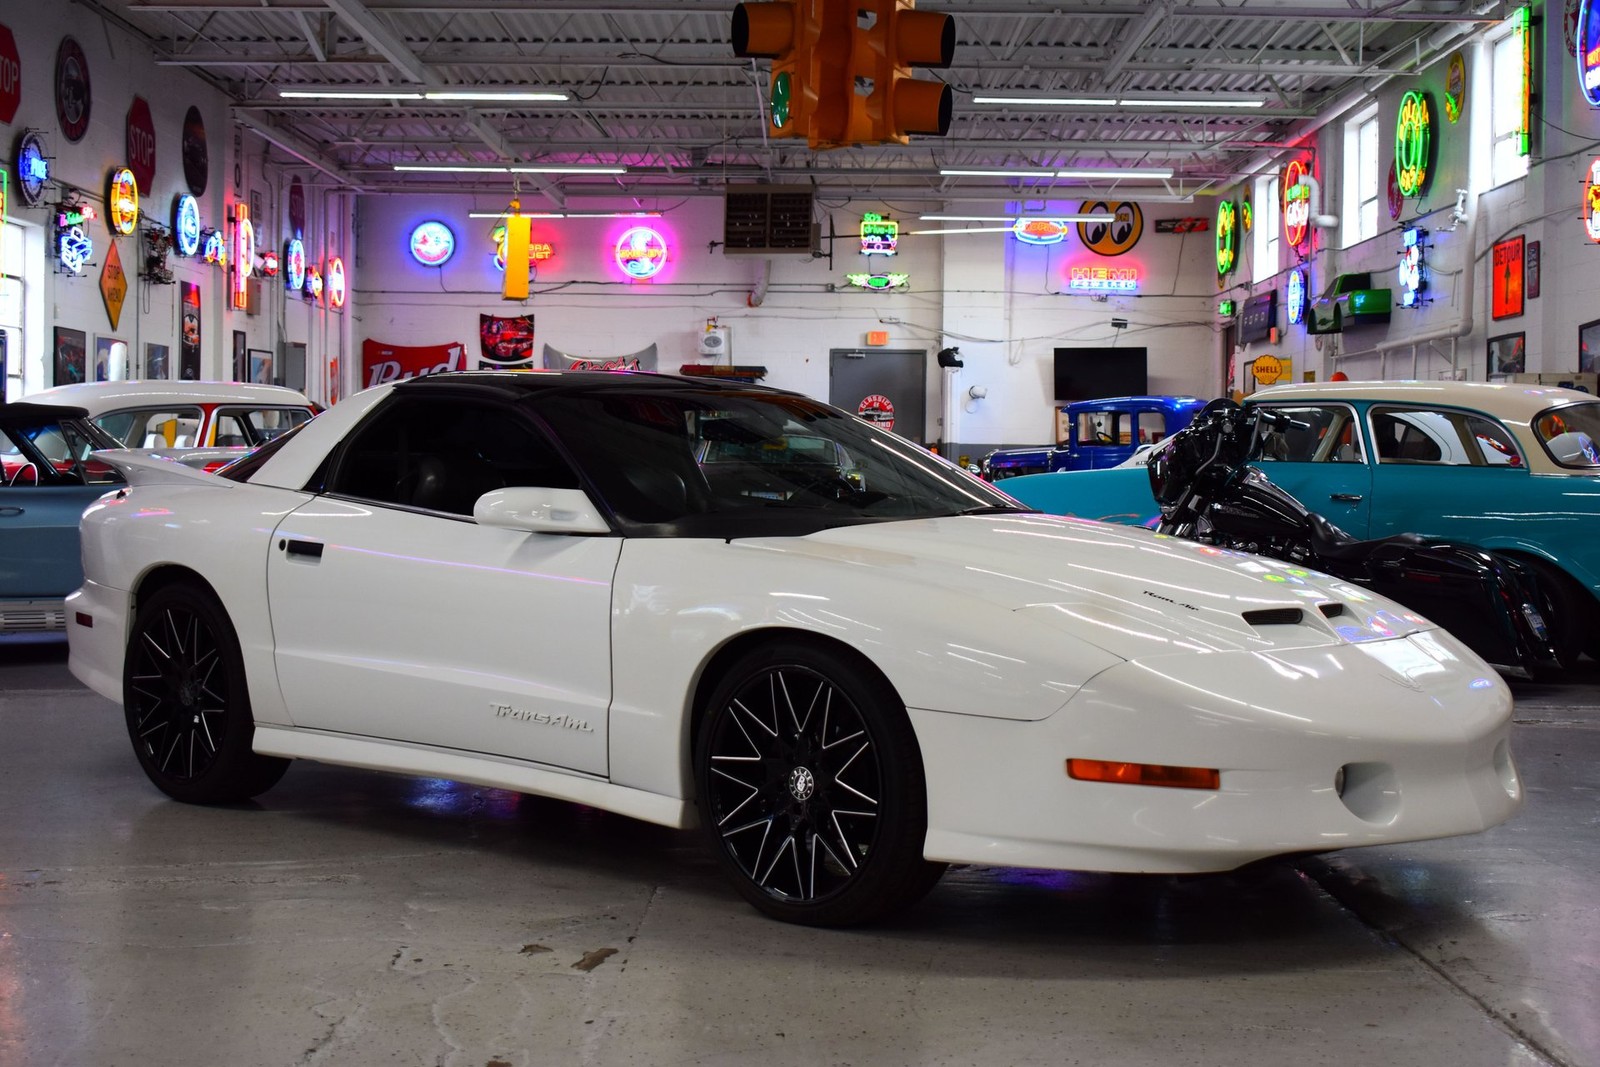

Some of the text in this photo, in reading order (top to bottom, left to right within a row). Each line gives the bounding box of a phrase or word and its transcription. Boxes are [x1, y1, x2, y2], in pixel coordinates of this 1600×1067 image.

[0, 55, 19, 95] TOP
[130, 124, 154, 167] STOP
[1115, 213, 1130, 223] ON
[528, 243, 551, 251] BRA
[1495, 243, 1520, 267] DETOUR
[1071, 267, 1137, 281] HEMI
[1255, 365, 1279, 374] SHELL
[860, 395, 893, 410] CLASSICS
